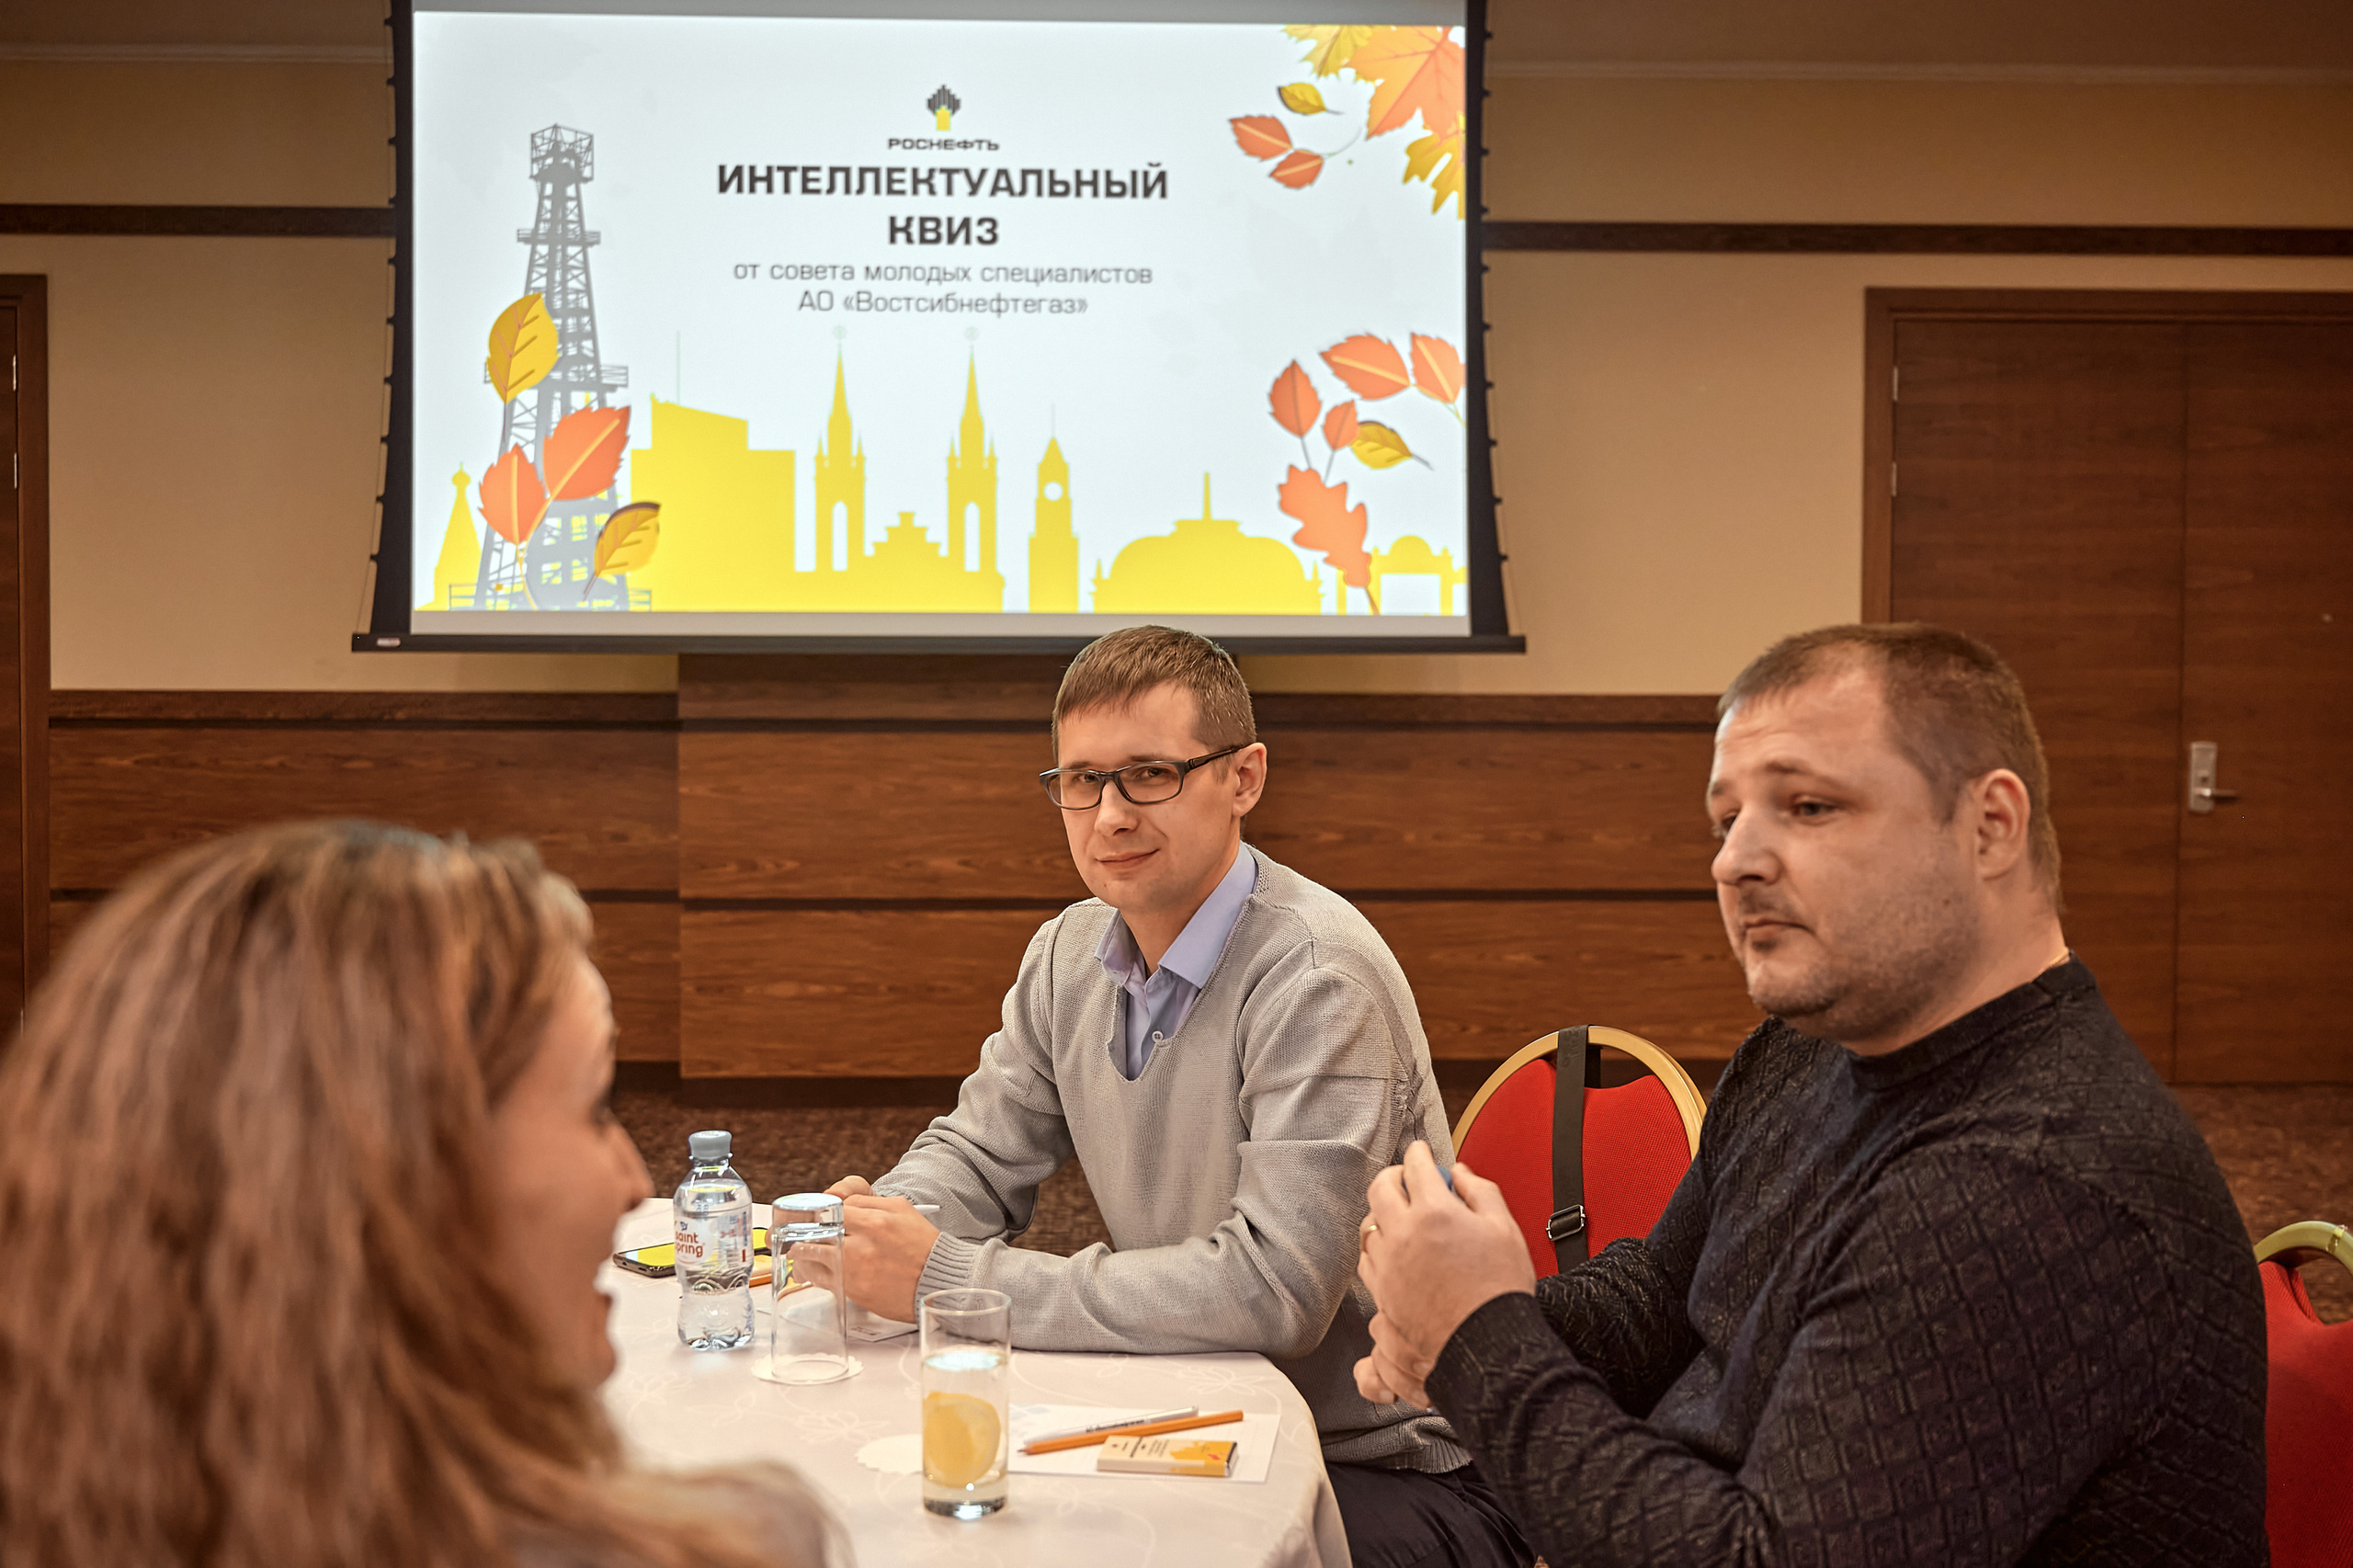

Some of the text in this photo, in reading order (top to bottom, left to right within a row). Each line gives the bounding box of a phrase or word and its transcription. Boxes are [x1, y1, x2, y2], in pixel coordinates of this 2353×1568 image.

[888, 138, 999, 151] РОСНЕФТЬ
[718, 162, 1168, 199] ИНТЕЛЛЕКТУАЛЬНЫЙ
[888, 216, 999, 245] КВИЗ
[733, 265, 1153, 286] от совета молодых специалистов
[799, 290, 1088, 318] АО «Востсибнефтегаз»
